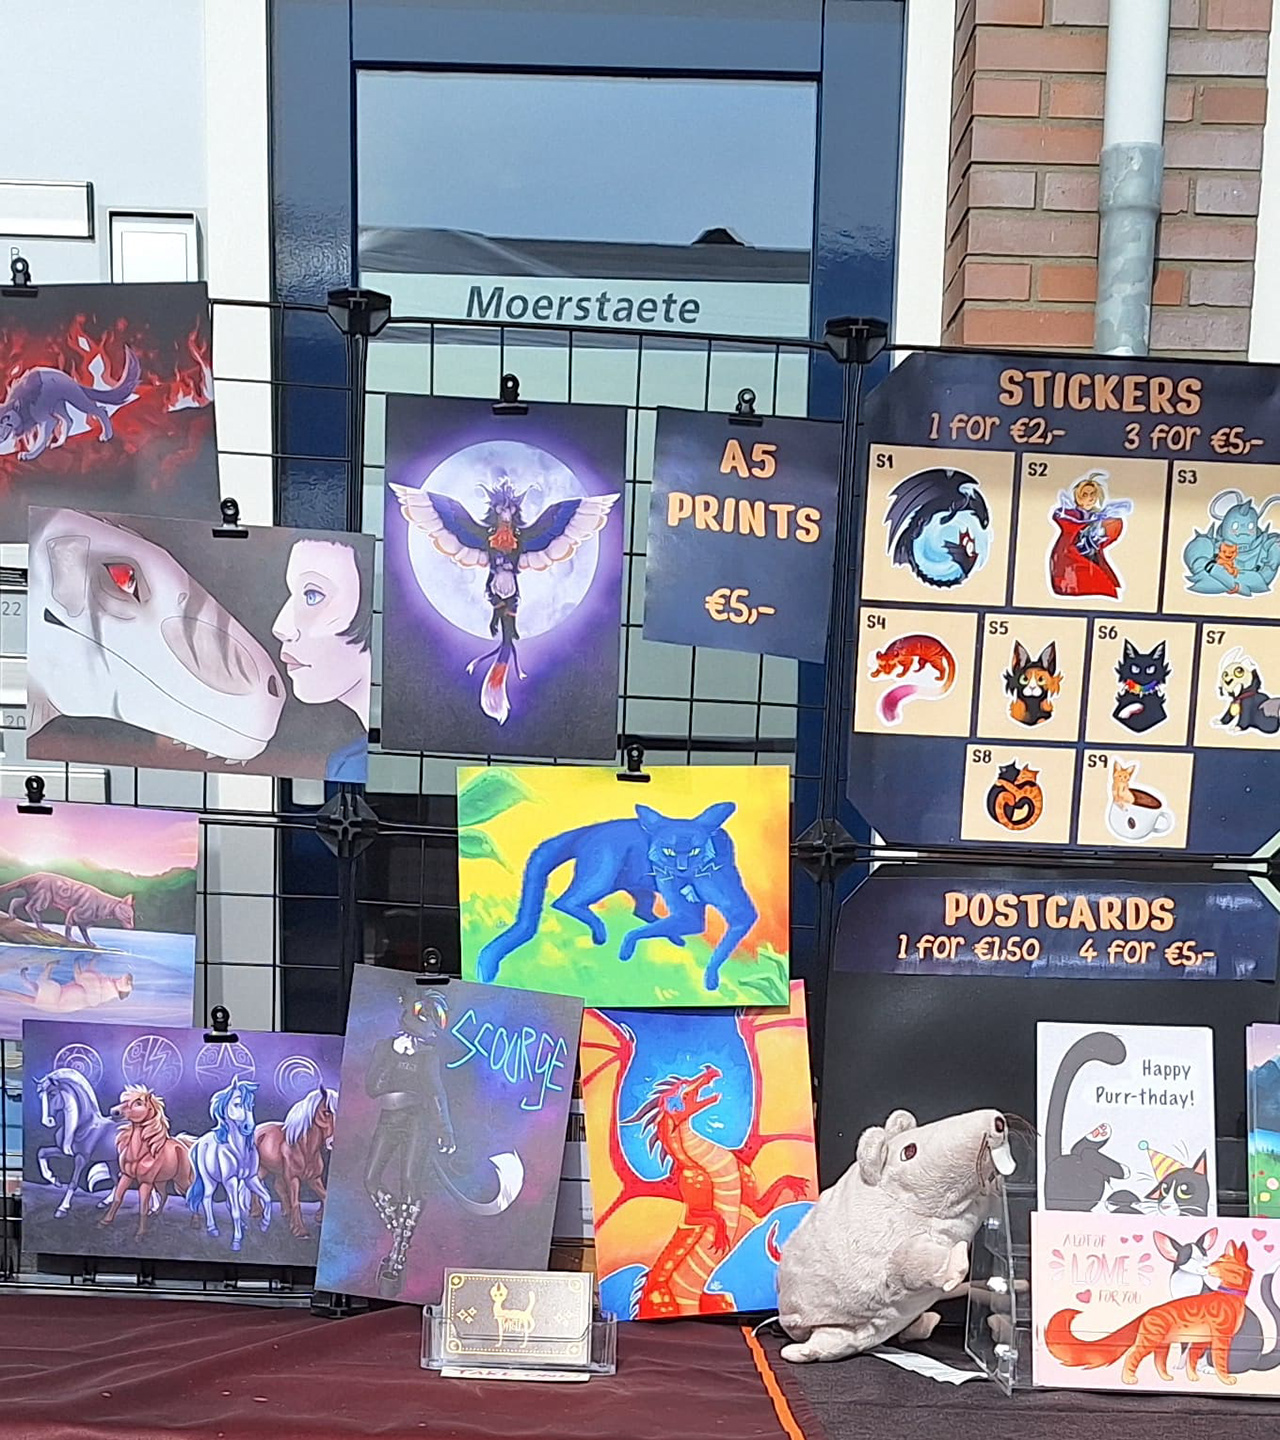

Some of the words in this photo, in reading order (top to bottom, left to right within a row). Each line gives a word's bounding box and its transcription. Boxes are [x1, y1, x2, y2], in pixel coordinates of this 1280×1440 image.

[466, 285, 701, 323] Moerstaete
[999, 369, 1203, 415] STICKERS
[929, 412, 940, 440] 1
[1009, 417, 1067, 445] €2,-
[1124, 422, 1140, 450] 3
[1210, 427, 1264, 455] €5,-
[720, 438, 778, 478] A5
[876, 453, 894, 469] S1
[1028, 462, 1048, 477] S2
[1177, 469, 1198, 484] S3
[667, 491, 821, 543] PRINTS
[2, 601, 22, 616] 22
[704, 587, 776, 625] €5,-
[867, 614, 886, 630] S4
[988, 620, 1009, 635] S5
[1098, 624, 1118, 640] S6
[1206, 630, 1226, 645] S7
[972, 749, 992, 764] S8
[1087, 754, 1108, 769] S9
[944, 891, 1176, 932] POSTCARDS
[898, 934, 908, 959] 1
[973, 935, 1040, 962] €1,50
[1079, 938, 1098, 963] 4
[1164, 940, 1215, 966] €5,-
[1142, 1059, 1191, 1080] Happy
[1096, 1086, 1194, 1109] Purr-thday!
[1071, 1253, 1131, 1286] LOVE
[1099, 1289, 1121, 1306] FOR
[1122, 1290, 1142, 1305] YOU
